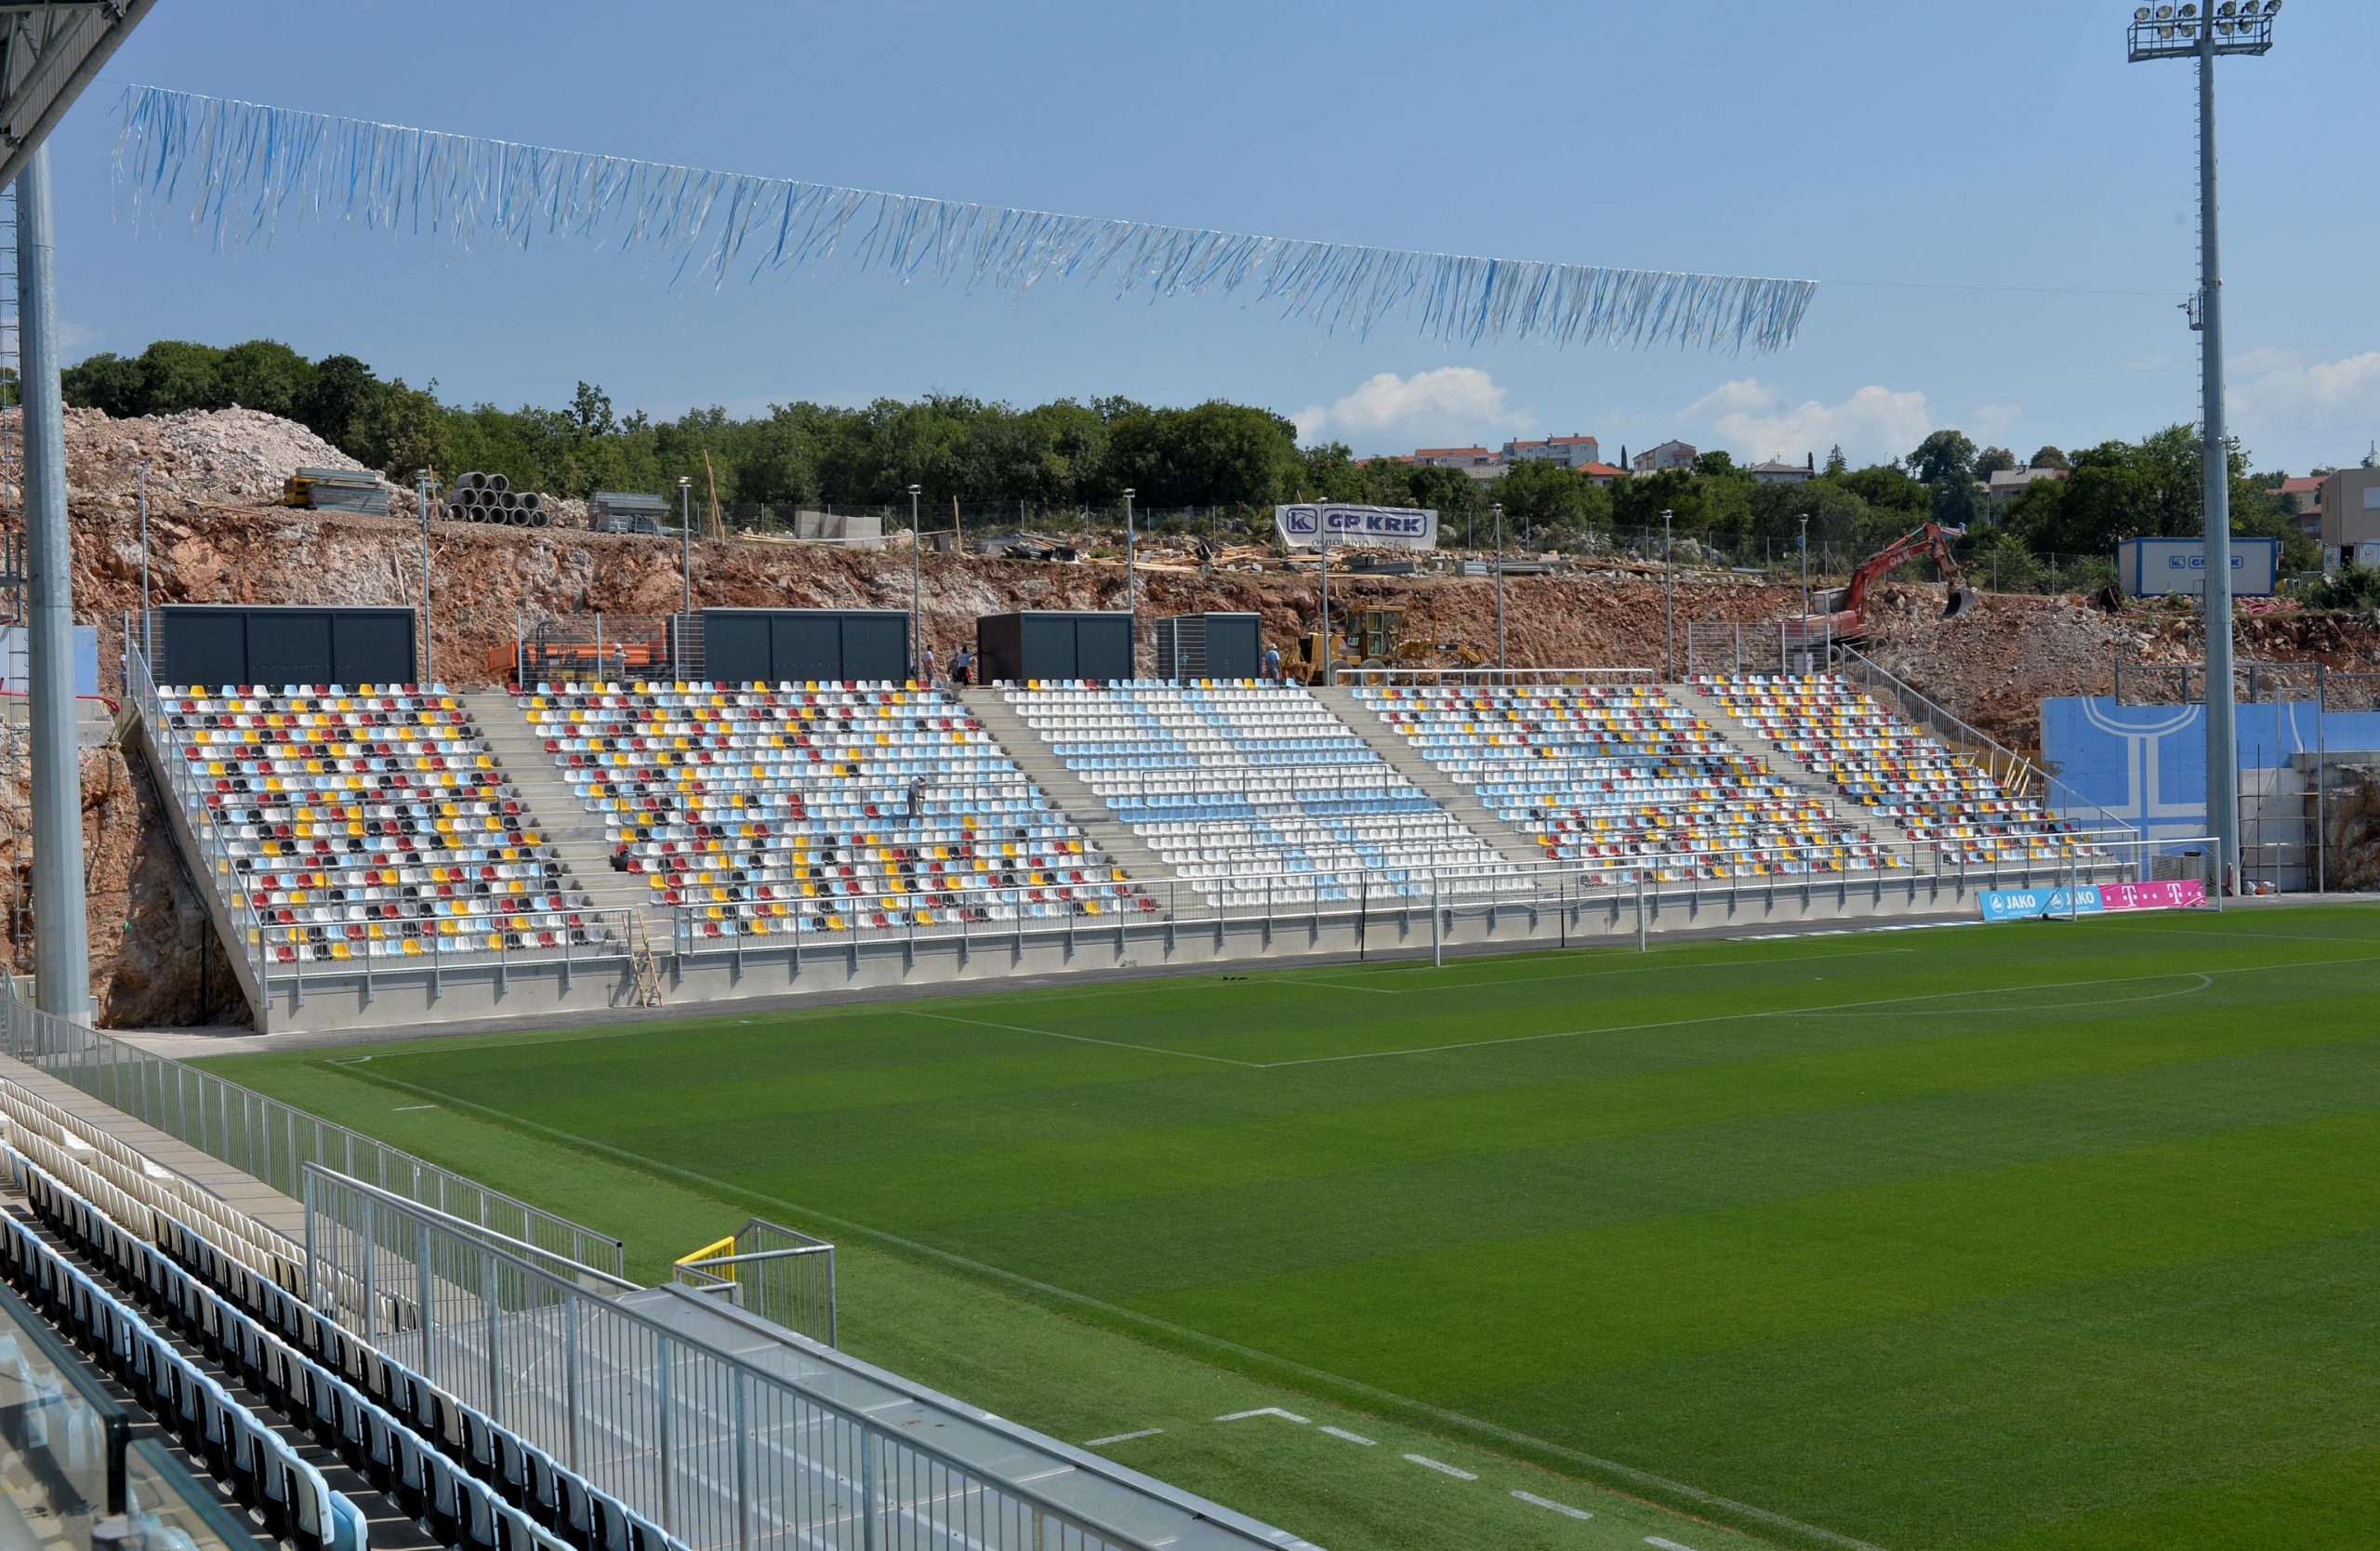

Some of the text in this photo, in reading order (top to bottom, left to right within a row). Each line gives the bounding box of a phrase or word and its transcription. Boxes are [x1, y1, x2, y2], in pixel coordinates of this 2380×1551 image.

[1328, 513, 1421, 533] GP KRK
[1348, 636, 1360, 646] CAT
[2006, 894, 2037, 909] JAKO
